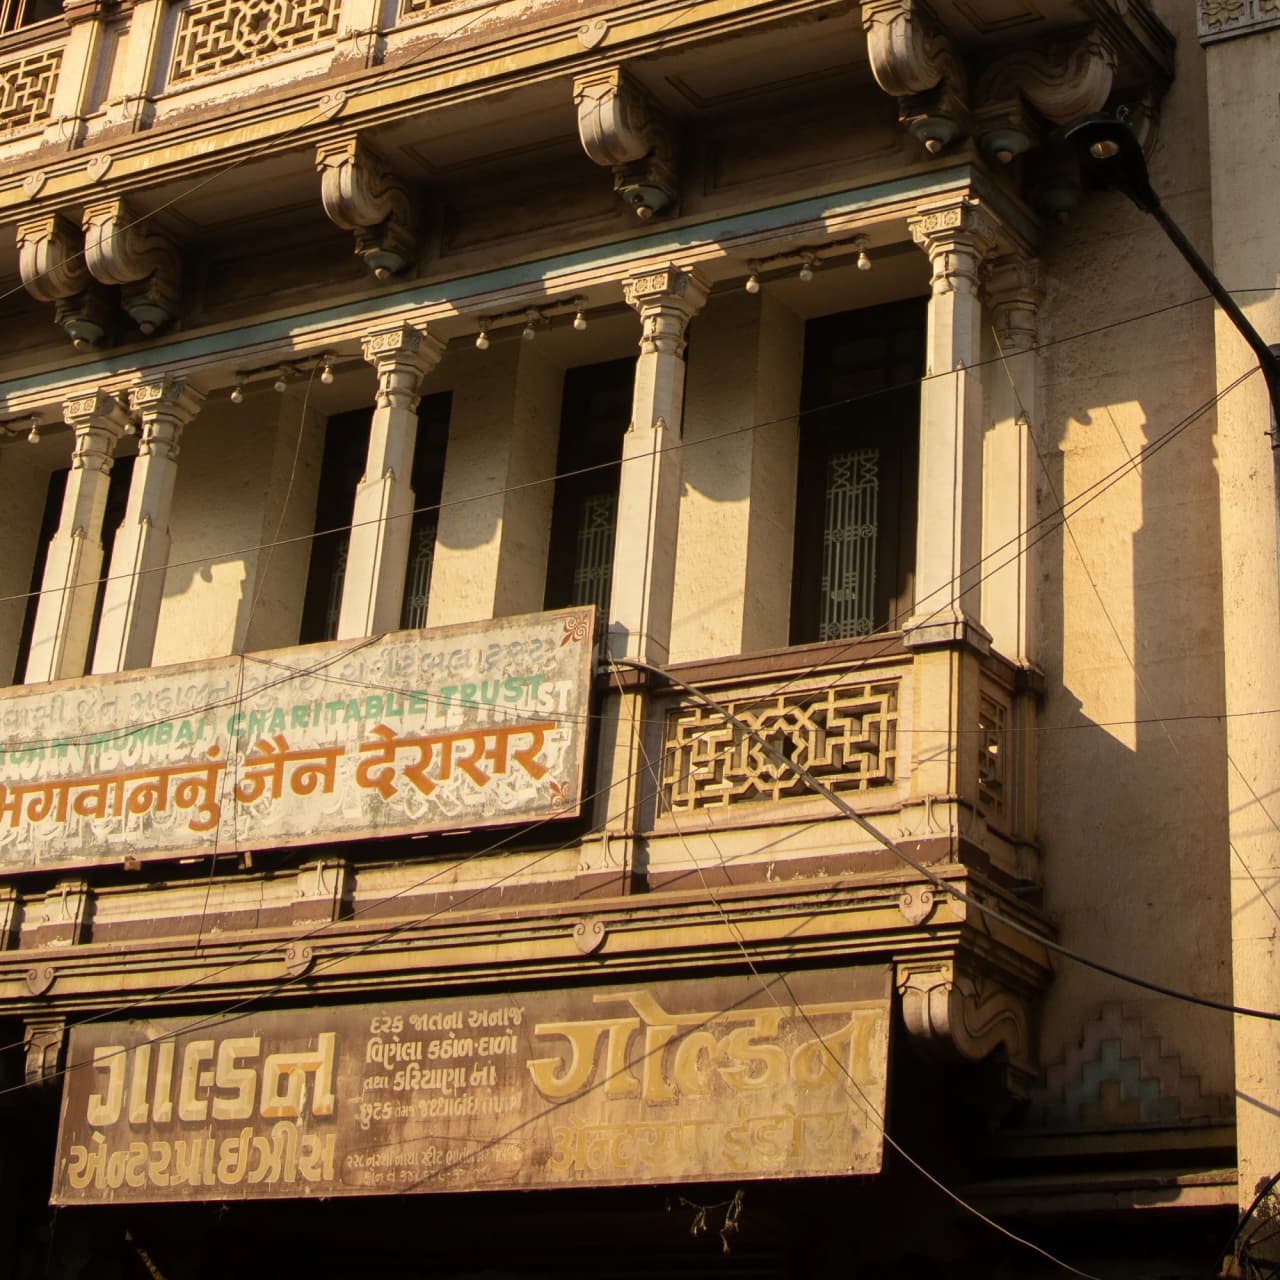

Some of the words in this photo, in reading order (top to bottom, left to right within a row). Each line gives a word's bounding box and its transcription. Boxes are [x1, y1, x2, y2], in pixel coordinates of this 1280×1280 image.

[227, 689, 426, 738] CHARITABLE
[440, 673, 546, 710] TRUST
[235, 735, 346, 803] जैन
[356, 723, 557, 800] देरासर
